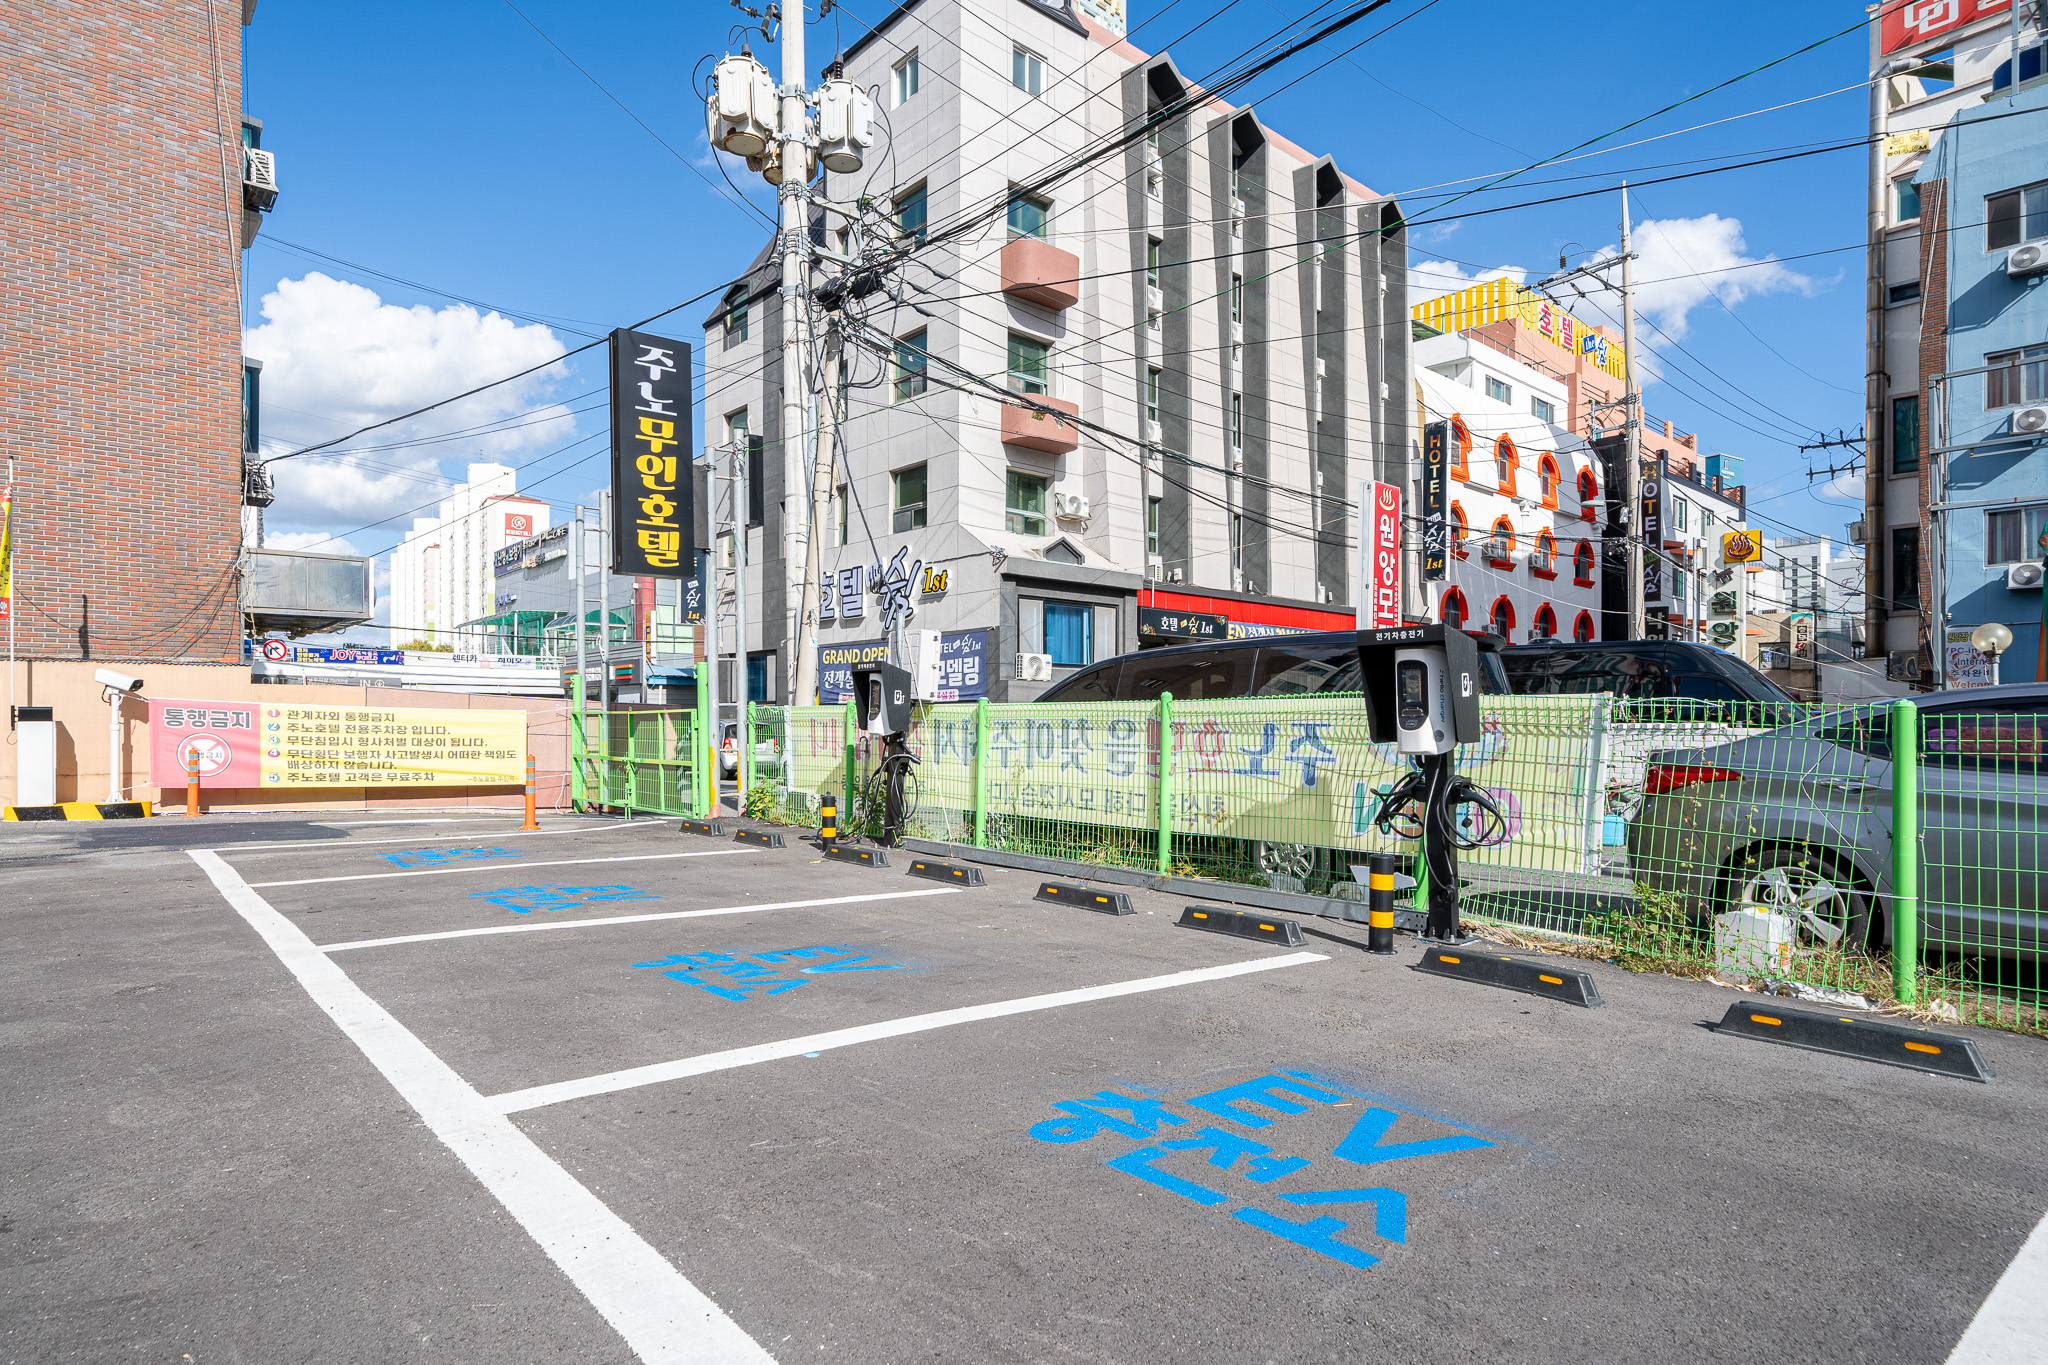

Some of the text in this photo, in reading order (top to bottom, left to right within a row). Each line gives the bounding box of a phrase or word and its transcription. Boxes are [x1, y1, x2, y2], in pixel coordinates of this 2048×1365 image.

[1540, 303, 1573, 348] 호텔
[1429, 434, 1441, 508] HOTEL
[1643, 465, 1658, 548] HOTEL
[1425, 557, 1443, 570] 1st
[922, 567, 947, 593] 1st
[687, 611, 700, 620] 1st
[1161, 616, 1177, 631] 호텔
[1201, 621, 1213, 634] 1st
[1375, 629, 1424, 641] 전기차충전기
[330, 650, 355, 660] JOY
[453, 654, 477, 663] 렌터카
[822, 648, 861, 664] GRAND
[360, 679, 371, 687] IN
[164, 708, 251, 728] 통행금지
[287, 710, 339, 721] 관계자외
[345, 712, 395, 722] 통행금지
[287, 722, 340, 733] 주노호텔
[345, 725, 407, 735] 전용주차장
[411, 725, 451, 735] 입니다.
[287, 735, 353, 746] 무단침입시
[358, 737, 407, 747] 형사처벌
[411, 737, 446, 747] 대상이
[450, 738, 488, 747] 됩니다.
[287, 749, 340, 759] 무단횡단
[344, 750, 381, 759] 보행자
[385, 750, 443, 759] 사고발생시
[448, 750, 481, 759] 어떠한
[485, 750, 517, 759] 책임도
[287, 760, 397, 770] 배상하지 않습니다.
[287, 772, 340, 782] 주노호텔
[345, 773, 382, 782] 고객은
[387, 772, 435, 782] 무료주차
[1185, 1074, 1498, 1165] EV
[1029, 1090, 1407, 1269] 충전소
